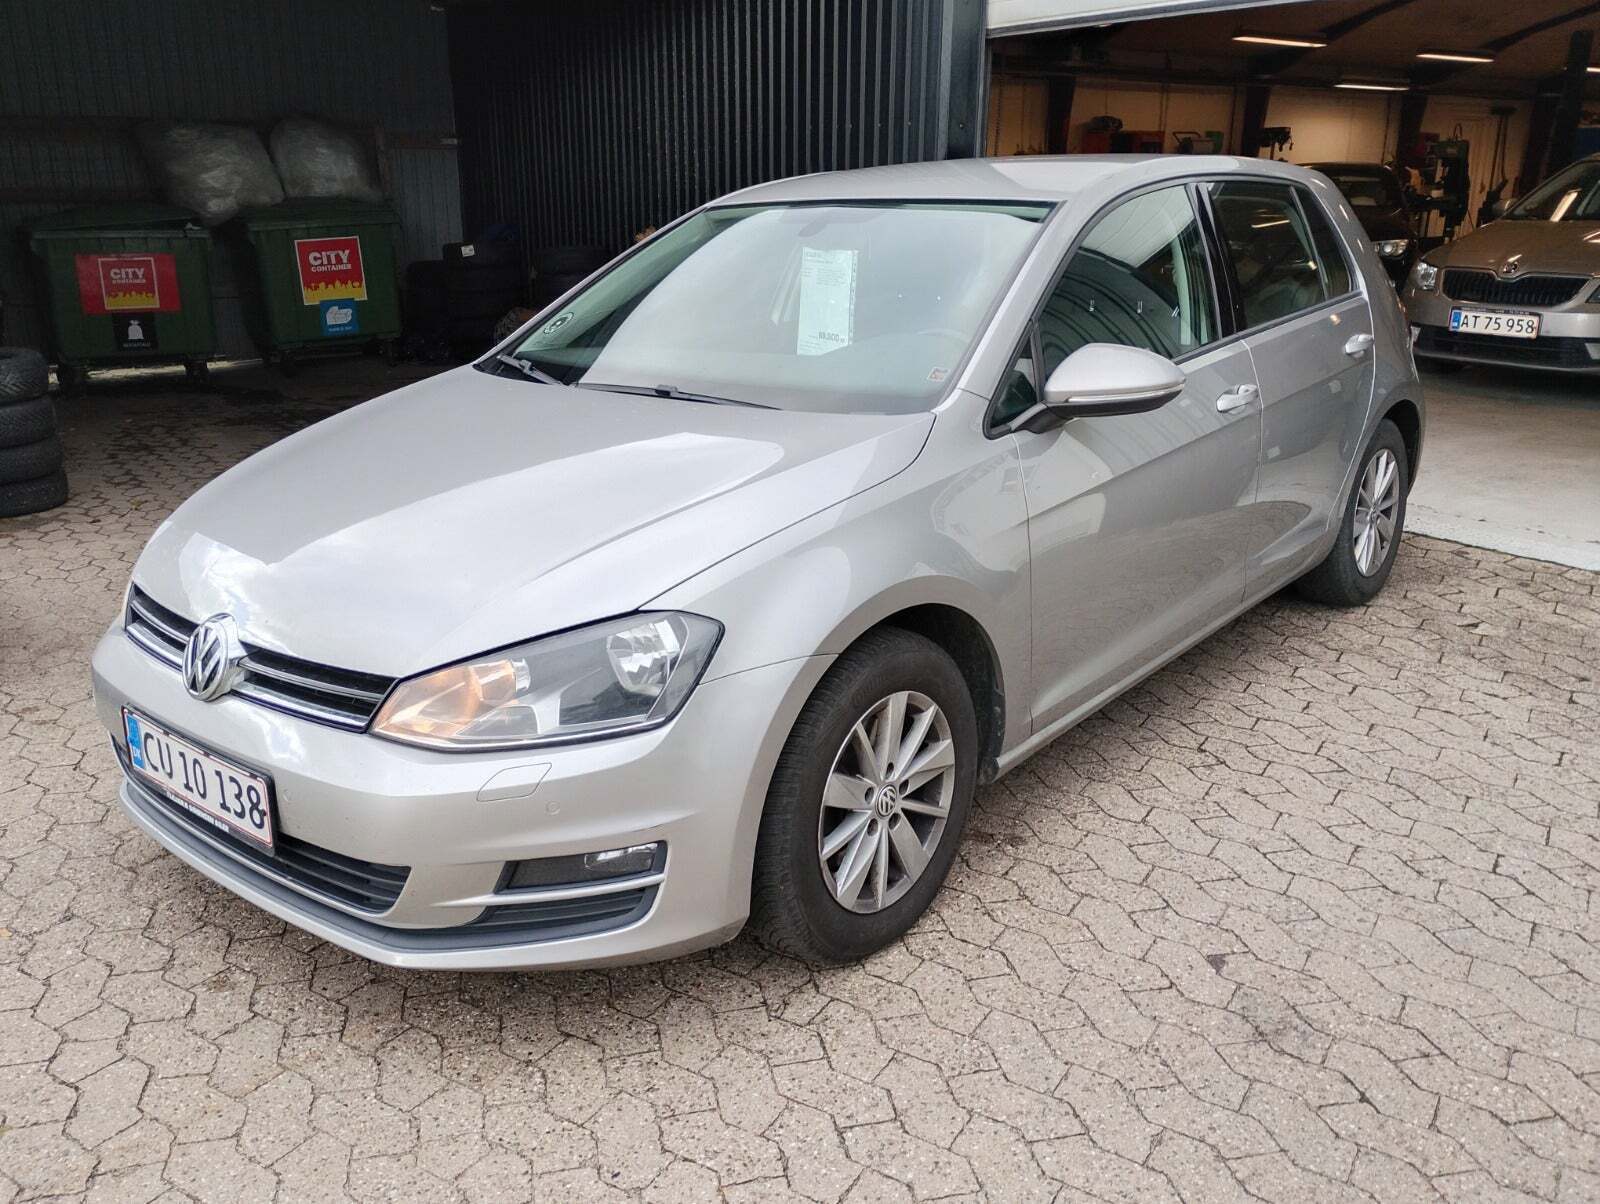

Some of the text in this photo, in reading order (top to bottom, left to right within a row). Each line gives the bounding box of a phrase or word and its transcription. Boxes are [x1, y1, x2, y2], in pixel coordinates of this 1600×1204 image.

[308, 249, 350, 266] CITY
[110, 267, 145, 279] CITY
[311, 263, 352, 272] CONTAINER
[1461, 314, 1535, 334] AT 75 958
[144, 732, 174, 780] CU
[178, 751, 207, 800] 10
[214, 769, 266, 829] 138
